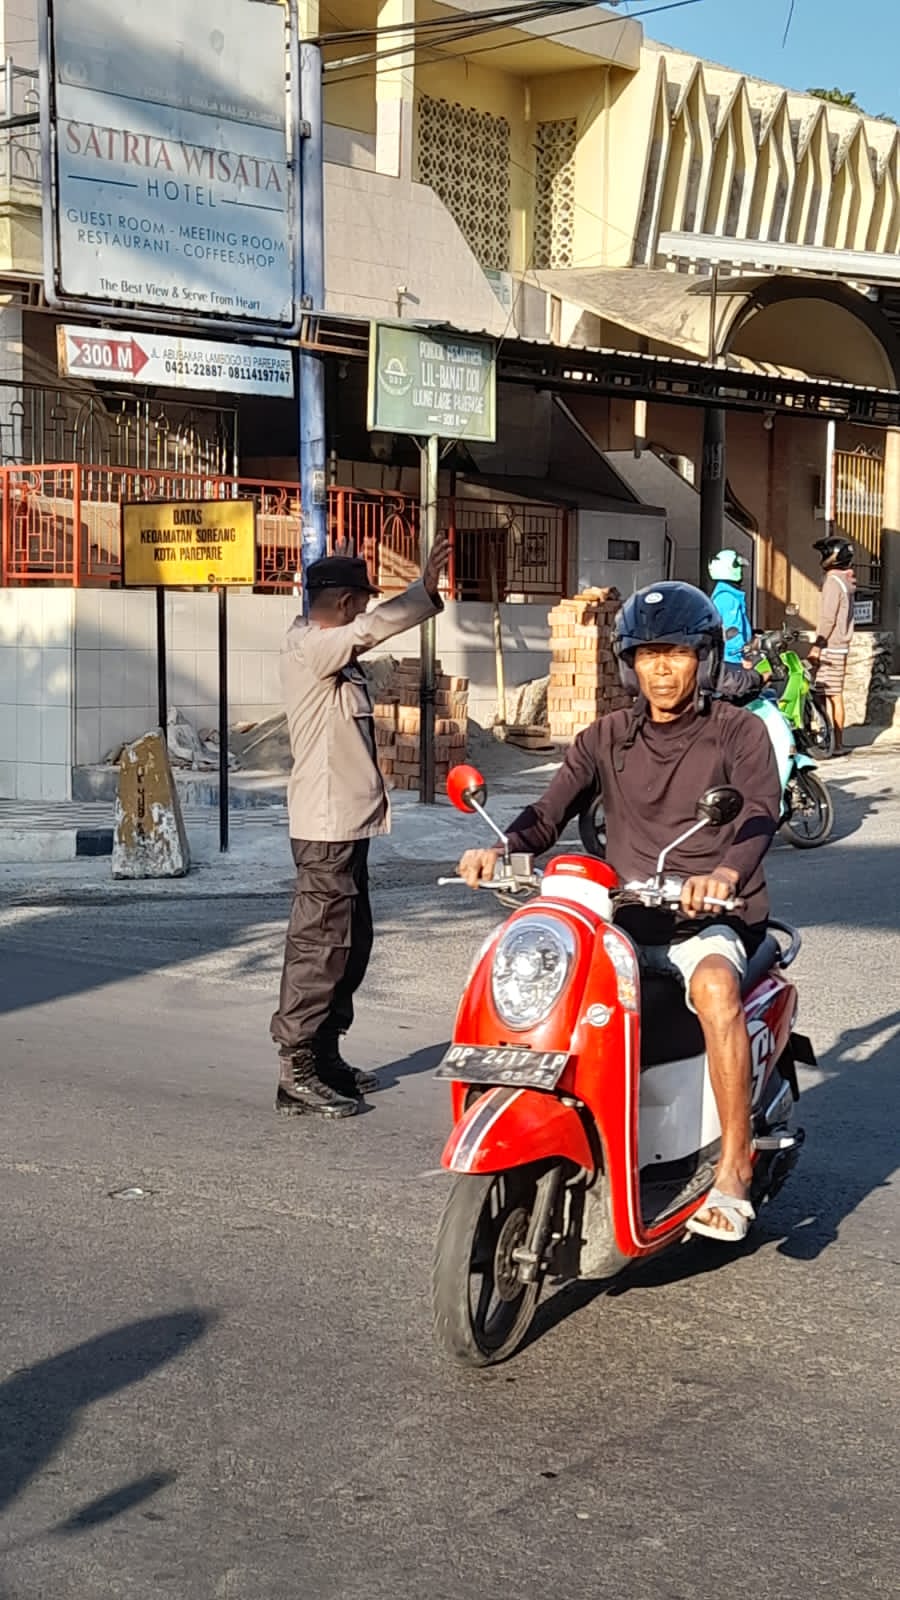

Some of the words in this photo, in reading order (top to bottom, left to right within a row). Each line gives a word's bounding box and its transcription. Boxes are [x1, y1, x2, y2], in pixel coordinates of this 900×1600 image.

[66, 121, 173, 172] SATRIA
[180, 142, 282, 192] WISATA
[147, 178, 217, 208] HOTEL
[66, 207, 113, 227] GUEST
[117, 215, 165, 235] ROOM
[178, 225, 238, 245] MEETING
[241, 234, 286, 251] ROOM
[77, 229, 170, 254] RESTAURANT
[99, 278, 119, 292] The
[120, 280, 143, 294] Best
[145, 283, 169, 298] View
[171, 286, 180, 298] &
[181, 287, 208, 303] Serve
[210, 291, 234, 307] From
[235, 295, 261, 310] Heart
[81, 343, 113, 367] 300
[117, 346, 133, 369] M
[173, 508, 203, 526] BATAS
[140, 528, 193, 545] KECAMATAN
[195, 527, 237, 543] SOREANG
[153, 547, 177, 562] KOTA
[179, 545, 223, 561] PAREPARE
[448, 1046, 476, 1064] DP
[481, 1049, 532, 1067] 2417
[538, 1053, 568, 1071] LP
